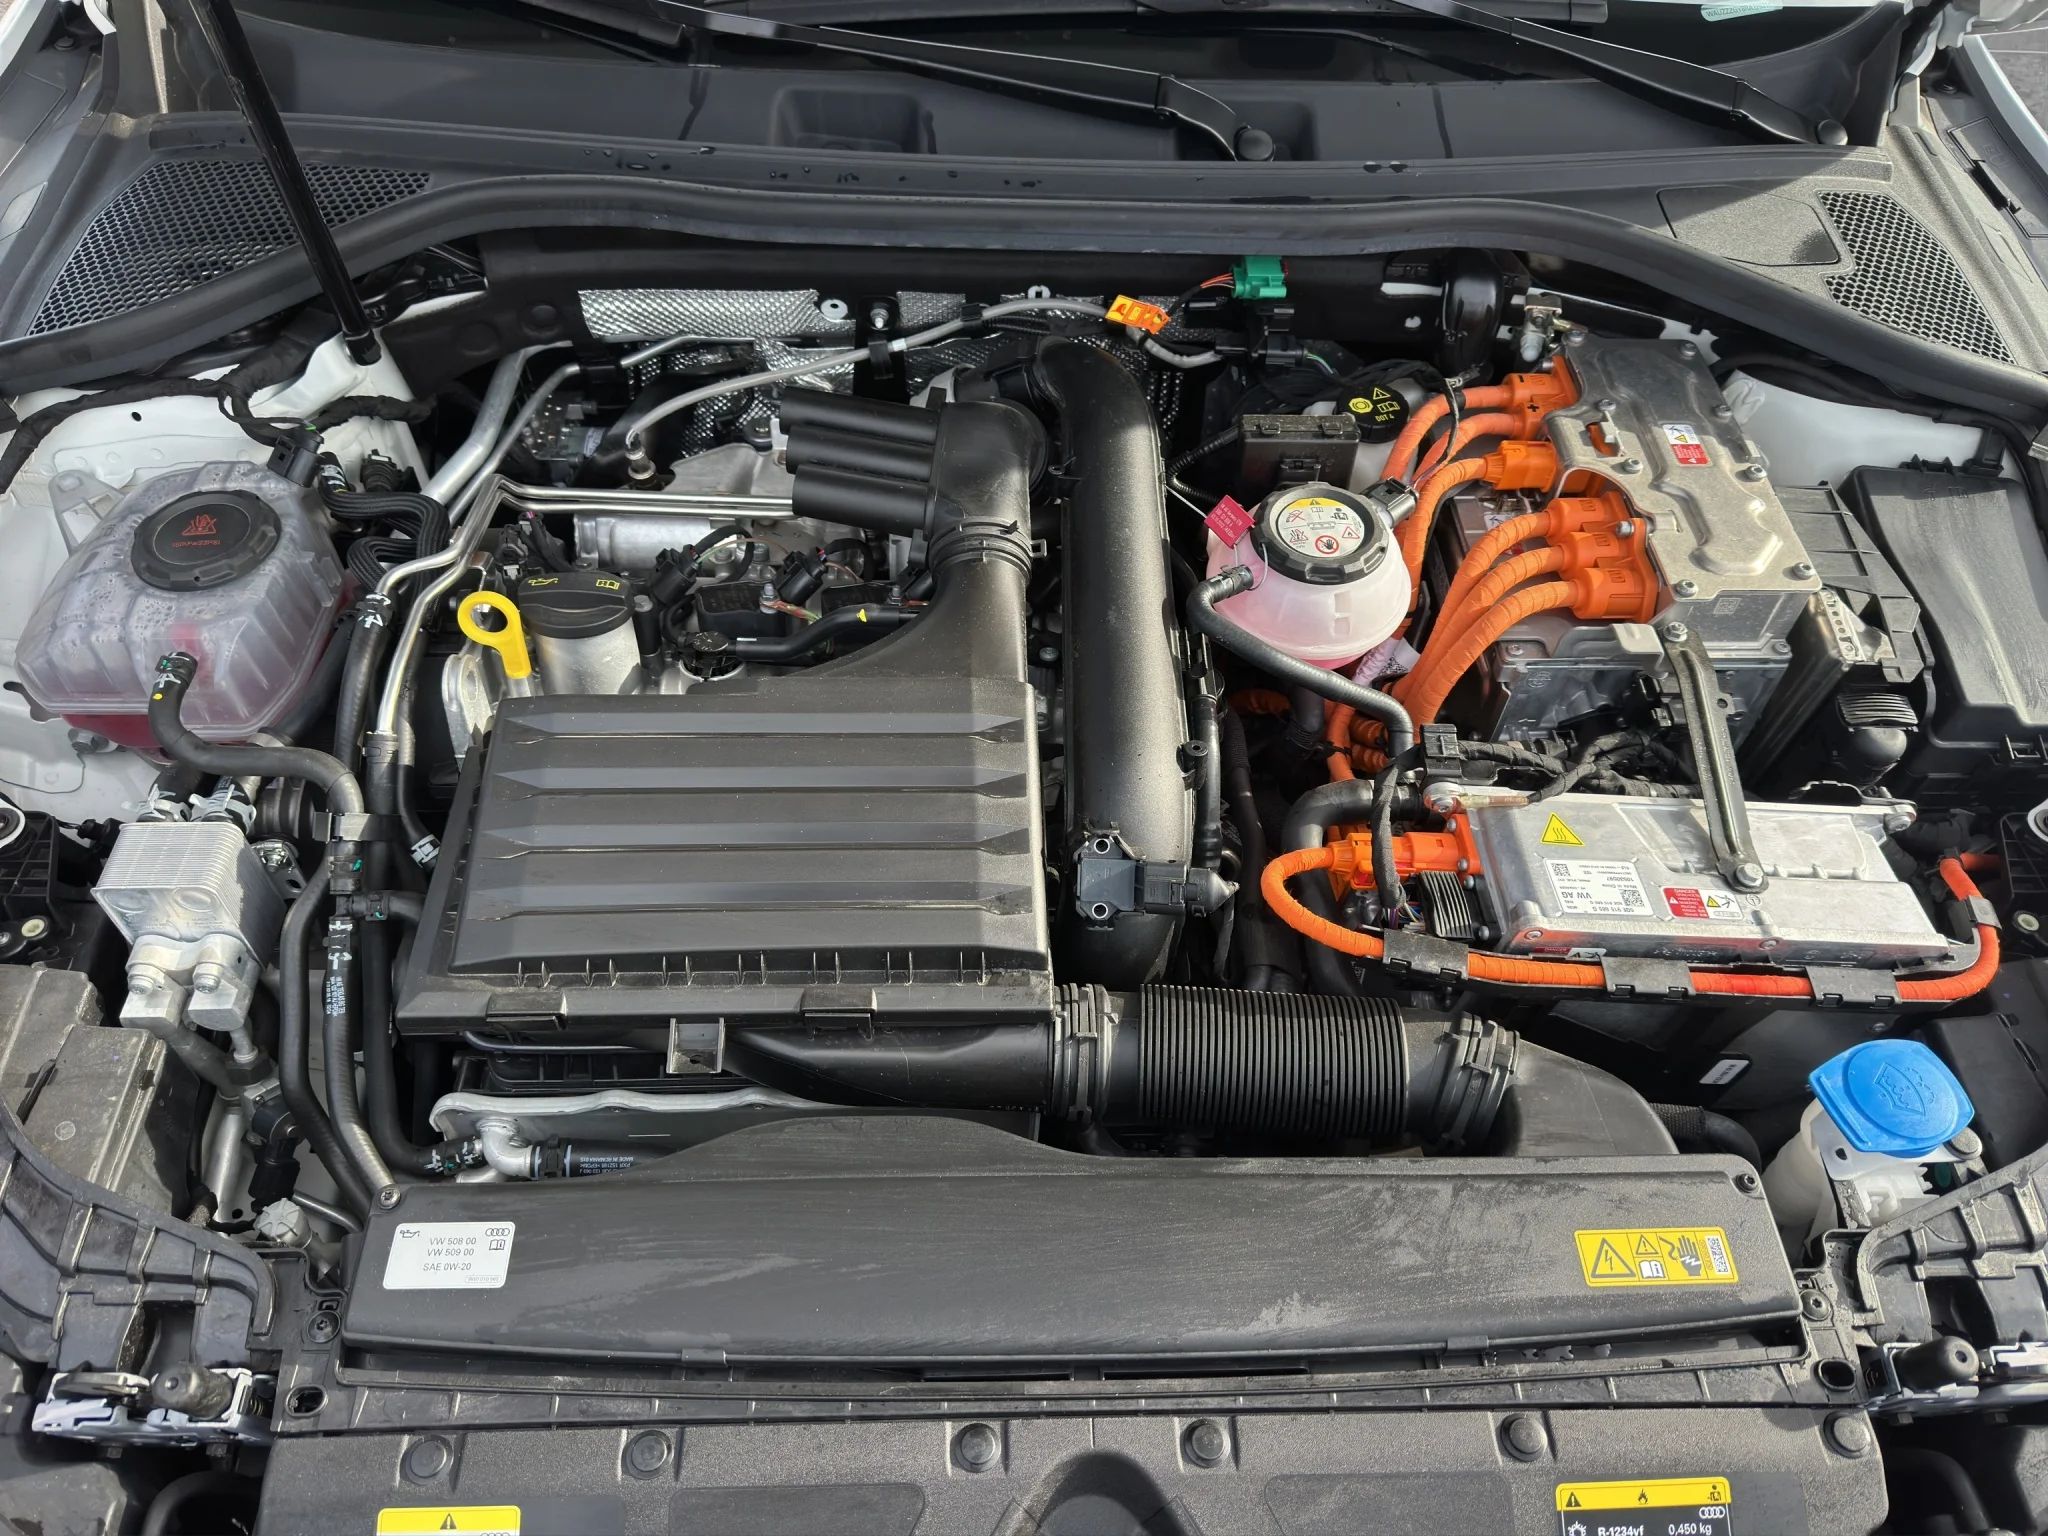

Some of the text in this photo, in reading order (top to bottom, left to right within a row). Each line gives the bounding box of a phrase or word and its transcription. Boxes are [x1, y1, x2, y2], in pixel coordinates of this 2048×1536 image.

[1375, 414, 1388, 422] DOT
[1561, 891, 1574, 899] AG
[429, 1237, 477, 1246] VW 508 00
[427, 1248, 475, 1257] VW 509 00
[423, 1262, 472, 1271] SAE 0W-20
[1597, 1523, 1712, 1536] R-1234yf 0,450 kg
